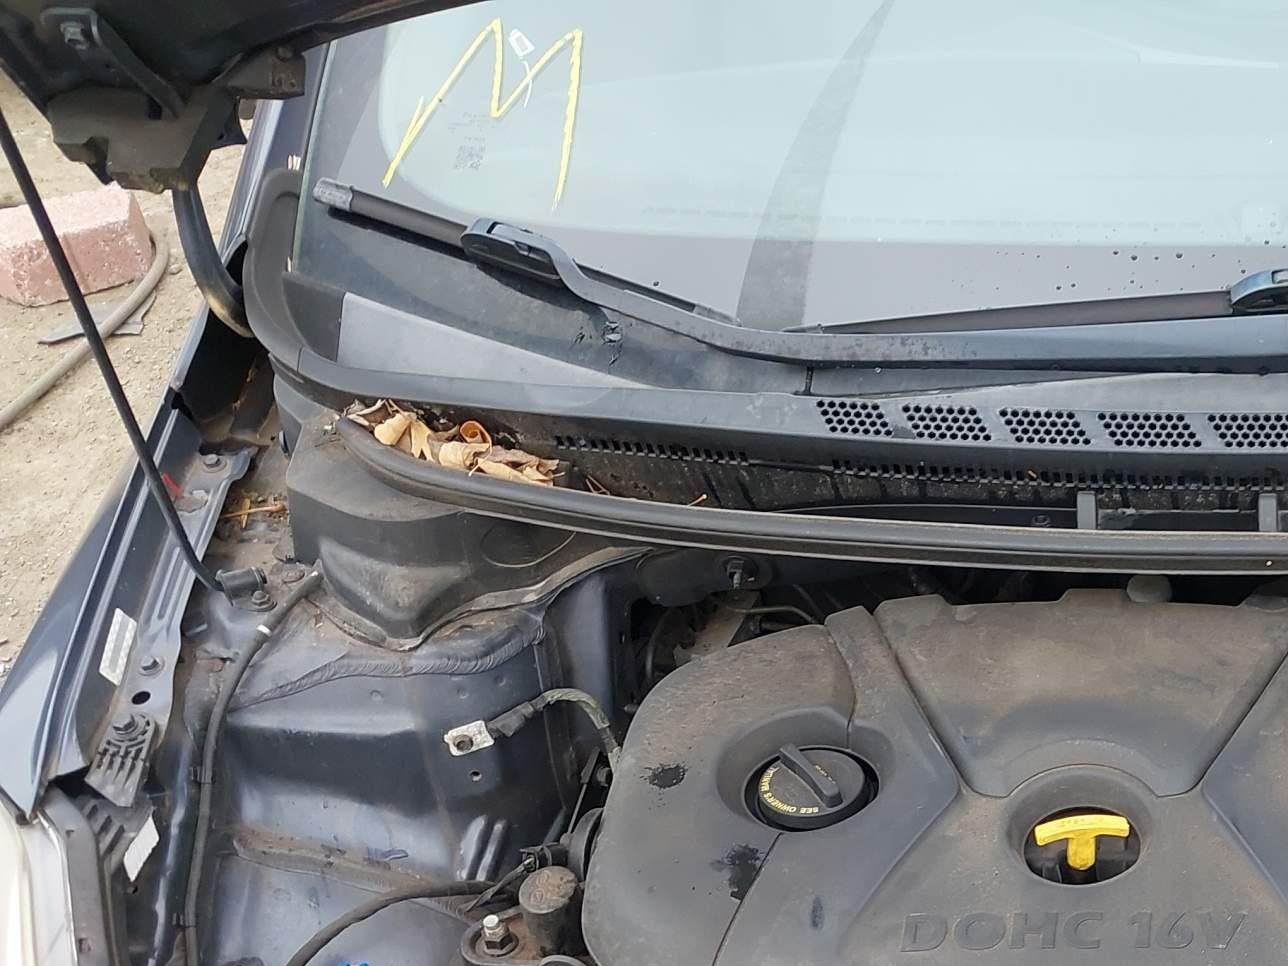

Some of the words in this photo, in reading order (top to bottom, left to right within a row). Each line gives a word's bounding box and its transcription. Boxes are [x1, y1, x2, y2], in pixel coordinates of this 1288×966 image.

[382, 17, 583, 213] M
[799, 806, 819, 814] SEE
[900, 911, 1104, 952] DOHC
[1130, 911, 1247, 950] 16V
